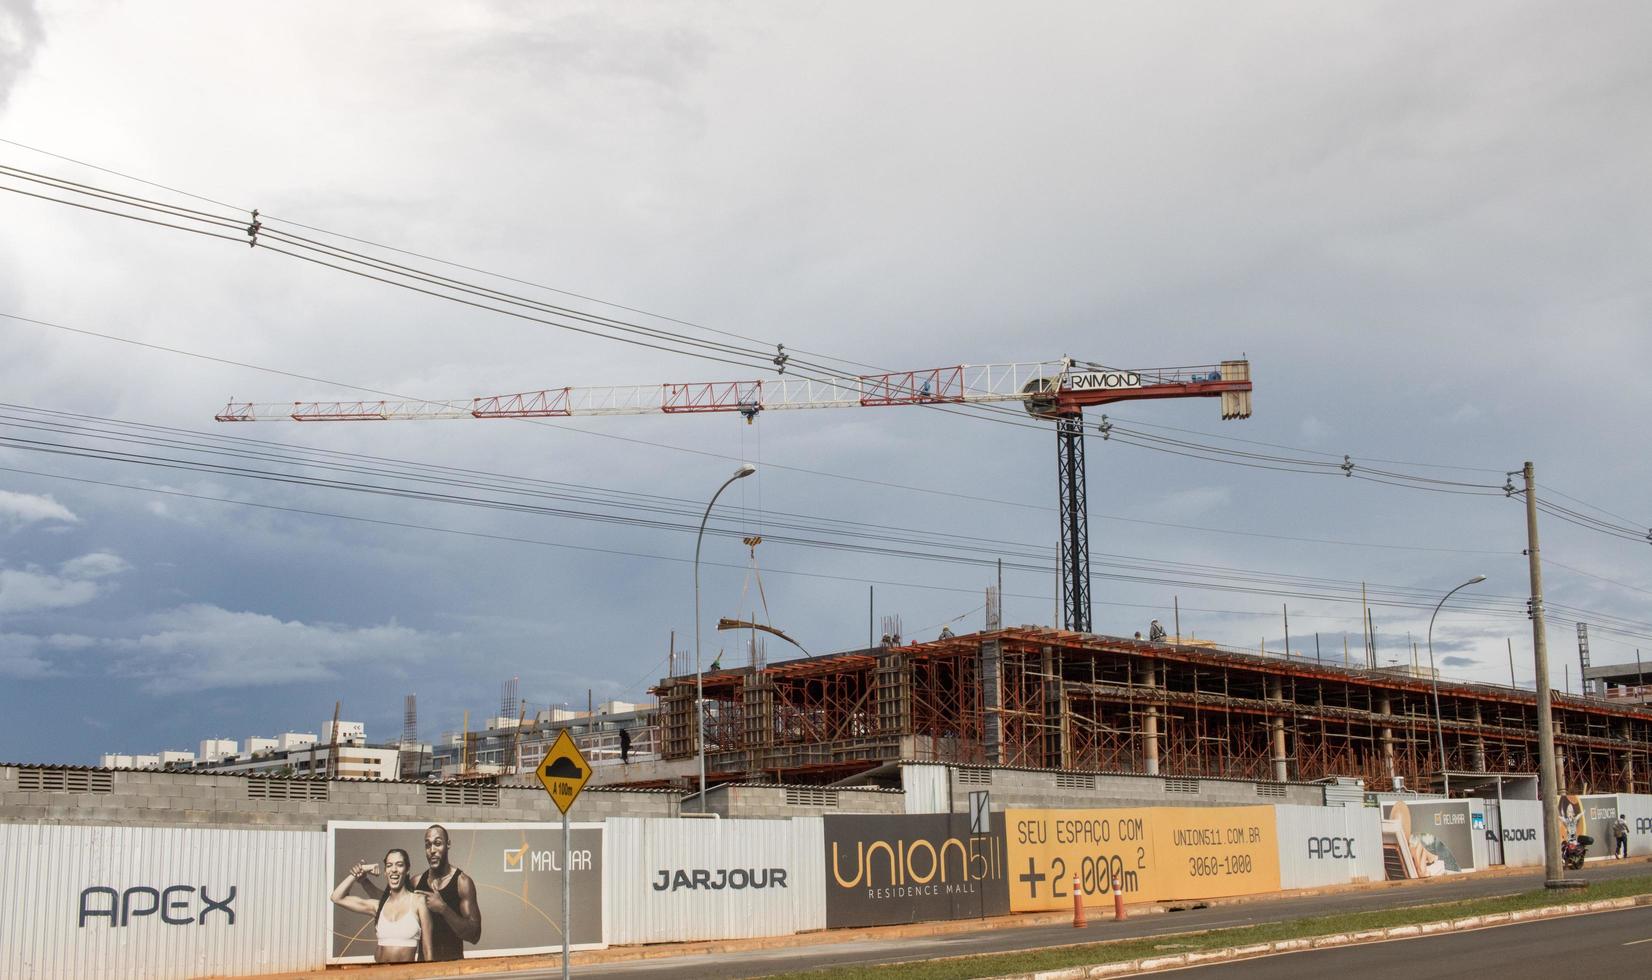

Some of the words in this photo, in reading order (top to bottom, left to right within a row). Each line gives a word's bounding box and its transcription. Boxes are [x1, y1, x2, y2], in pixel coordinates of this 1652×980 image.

[1071, 374, 1141, 389] RAIMONDI
[552, 781, 558, 795] A
[558, 782, 573, 796] 100m
[1017, 820, 1047, 844] SEU
[1056, 820, 1110, 846] ESPAÇO
[1118, 818, 1144, 841] COM
[1173, 826, 1261, 847] UNION511.COM.BR
[1307, 836, 1356, 859] APEX
[1188, 854, 1252, 877] 3060-1000
[652, 868, 788, 892] JARJOUR
[868, 885, 939, 899] RESIDENCE
[946, 883, 976, 894] MALL
[78, 885, 237, 928] APEX
